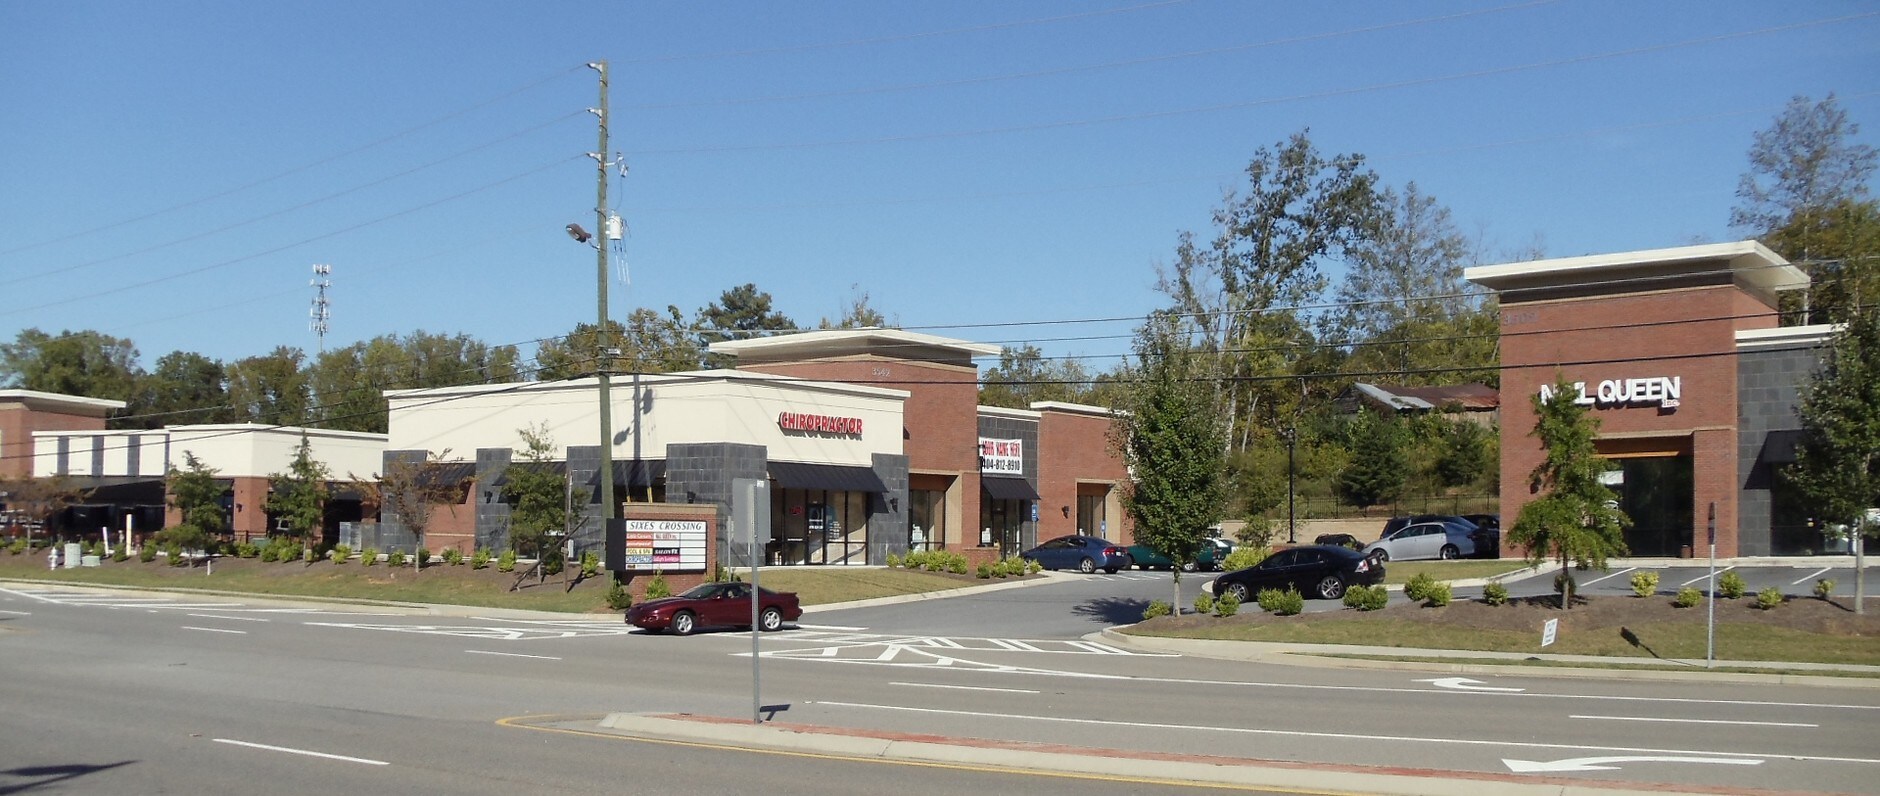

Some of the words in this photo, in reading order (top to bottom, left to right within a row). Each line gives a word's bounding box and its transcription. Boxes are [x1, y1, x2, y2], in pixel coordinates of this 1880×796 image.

[1598, 376, 1680, 403] QUEEN
[780, 411, 863, 434] CHIROPRACTOR
[630, 521, 655, 530] SIXES
[659, 521, 703, 531] CROSSING
